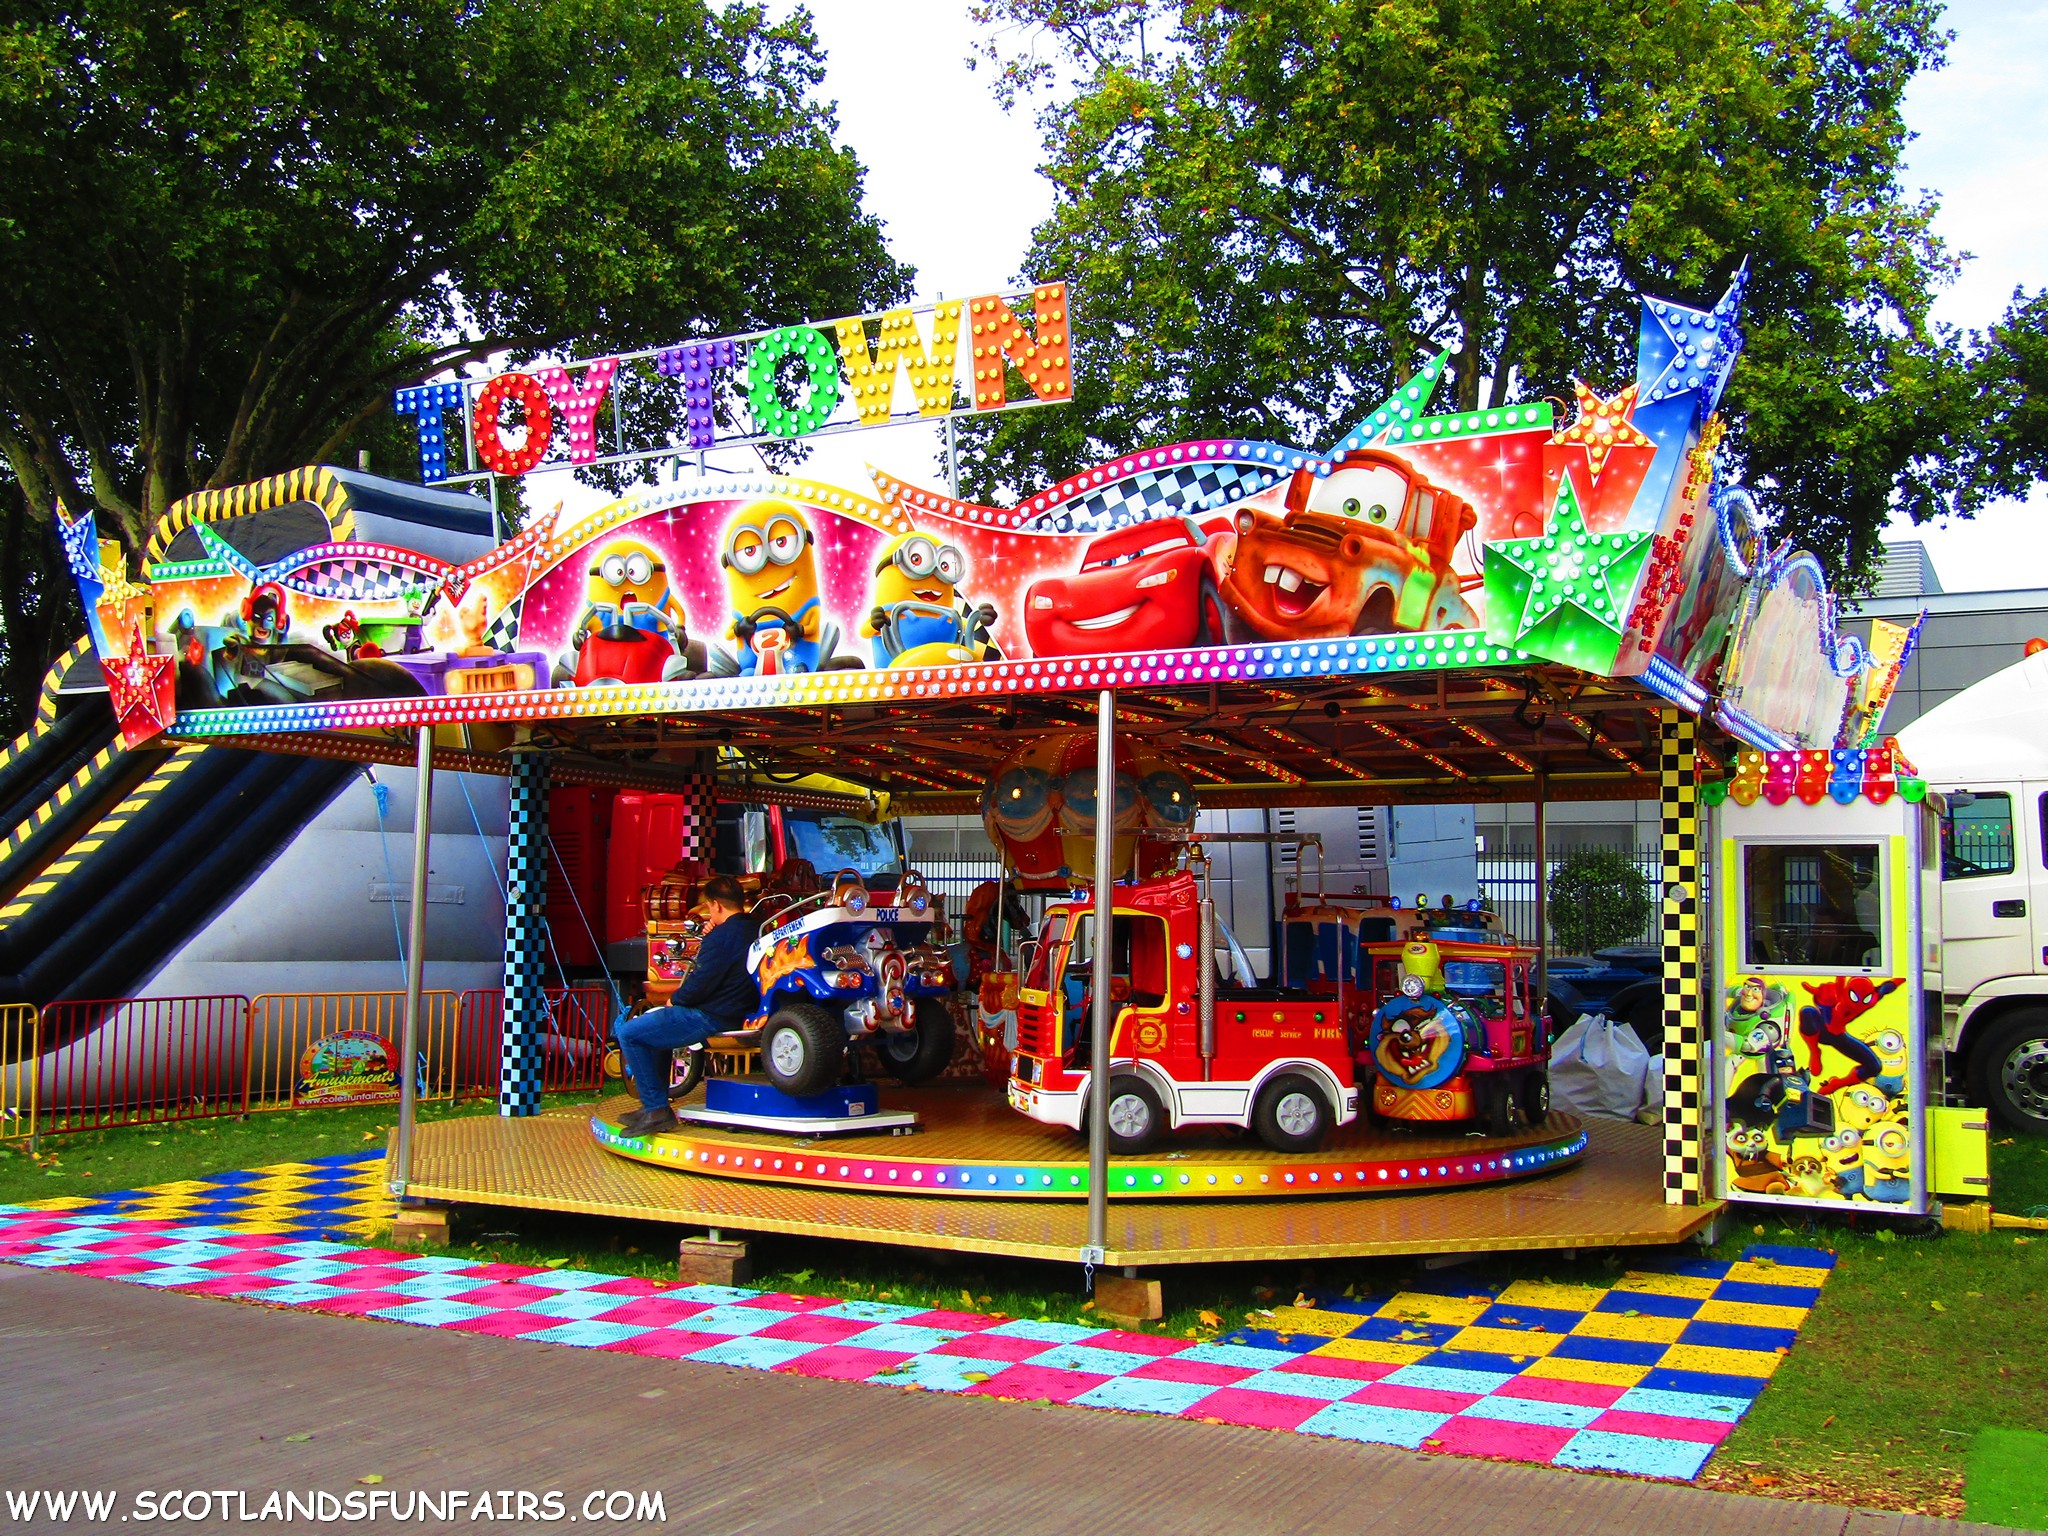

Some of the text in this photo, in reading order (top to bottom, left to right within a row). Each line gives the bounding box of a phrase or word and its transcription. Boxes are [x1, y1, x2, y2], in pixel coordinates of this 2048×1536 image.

[396, 283, 1073, 483] TOY TOWN
[761, 630, 780, 649] 2
[876, 908, 899, 921] POLICE
[772, 917, 805, 941] DEPARTEMENT
[1252, 1029, 1274, 1038] rescue
[299, 1071, 396, 1089] Amusements
[298, 1091, 400, 1105] www.colesfunfair.com
